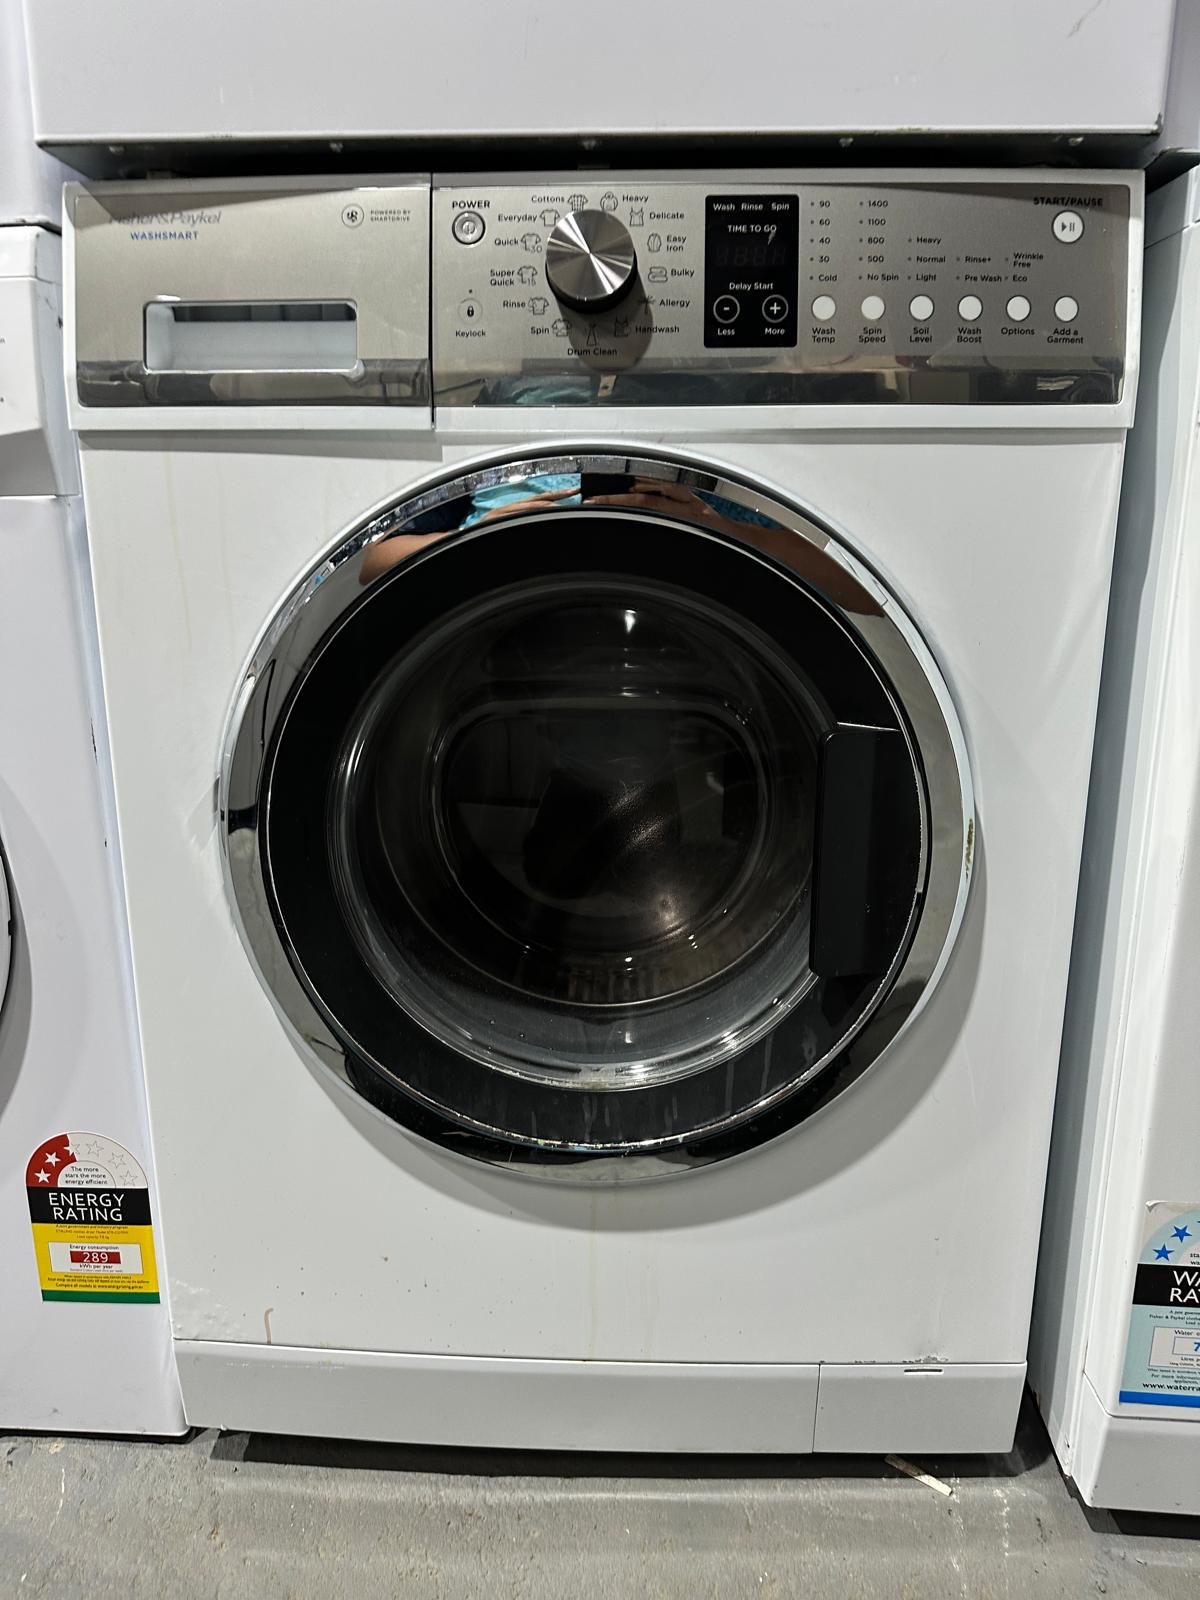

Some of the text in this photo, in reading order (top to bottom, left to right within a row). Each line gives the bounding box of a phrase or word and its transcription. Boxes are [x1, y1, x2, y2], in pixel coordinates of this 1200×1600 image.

[532, 195, 565, 203] Cottons
[622, 194, 649, 203] Heavy
[1033, 196, 1103, 207] START/PAUSE
[452, 200, 491, 209] POWER
[713, 202, 790, 211] Wash Rinse Spin
[819, 200, 831, 208] 90
[868, 200, 889, 208] 1400
[498, 213, 538, 222] Everyday
[650, 212, 685, 220] Delicate
[868, 218, 886, 226] 1100
[728, 224, 777, 233] TIME TO GO
[130, 231, 198, 241] WASHSMART
[667, 235, 687, 244] Easy
[494, 238, 519, 246] Quick
[916, 236, 942, 245] Heavy
[868, 255, 885, 263] 500
[916, 255, 946, 263] Normal
[965, 255, 992, 263] Rinse+
[1013, 252, 1044, 260] Wrinkle
[490, 269, 515, 278] Super
[671, 268, 695, 277] Bulky
[818, 274, 838, 282] Cold
[881, 274, 899, 283] Spin
[916, 273, 937, 282] Light
[965, 274, 1002, 282] Pre Wash
[490, 279, 515, 287] Quick
[729, 282, 774, 291] Delay Start
[503, 300, 526, 308] Rinse
[660, 299, 690, 308] Allergy
[531, 327, 550, 335] Spin
[635, 325, 680, 333] Handwash
[717, 328, 735, 336] Less
[812, 327, 836, 335] Wash
[863, 327, 882, 336] Spin
[913, 327, 930, 335] Soil
[958, 327, 982, 335] Wash
[1001, 327, 1035, 336] Options
[1053, 328, 1069, 336] Add
[455, 329, 486, 338] Keylock
[812, 336, 835, 344] Temp
[858, 336, 886, 344] Speed
[1047, 336, 1084, 345] Garment
[568, 348, 618, 356] Drum Clean
[49, 1192, 125, 1207] ENERGY
[53, 1207, 123, 1222] RATING
[82, 1252, 108, 1263] 289
